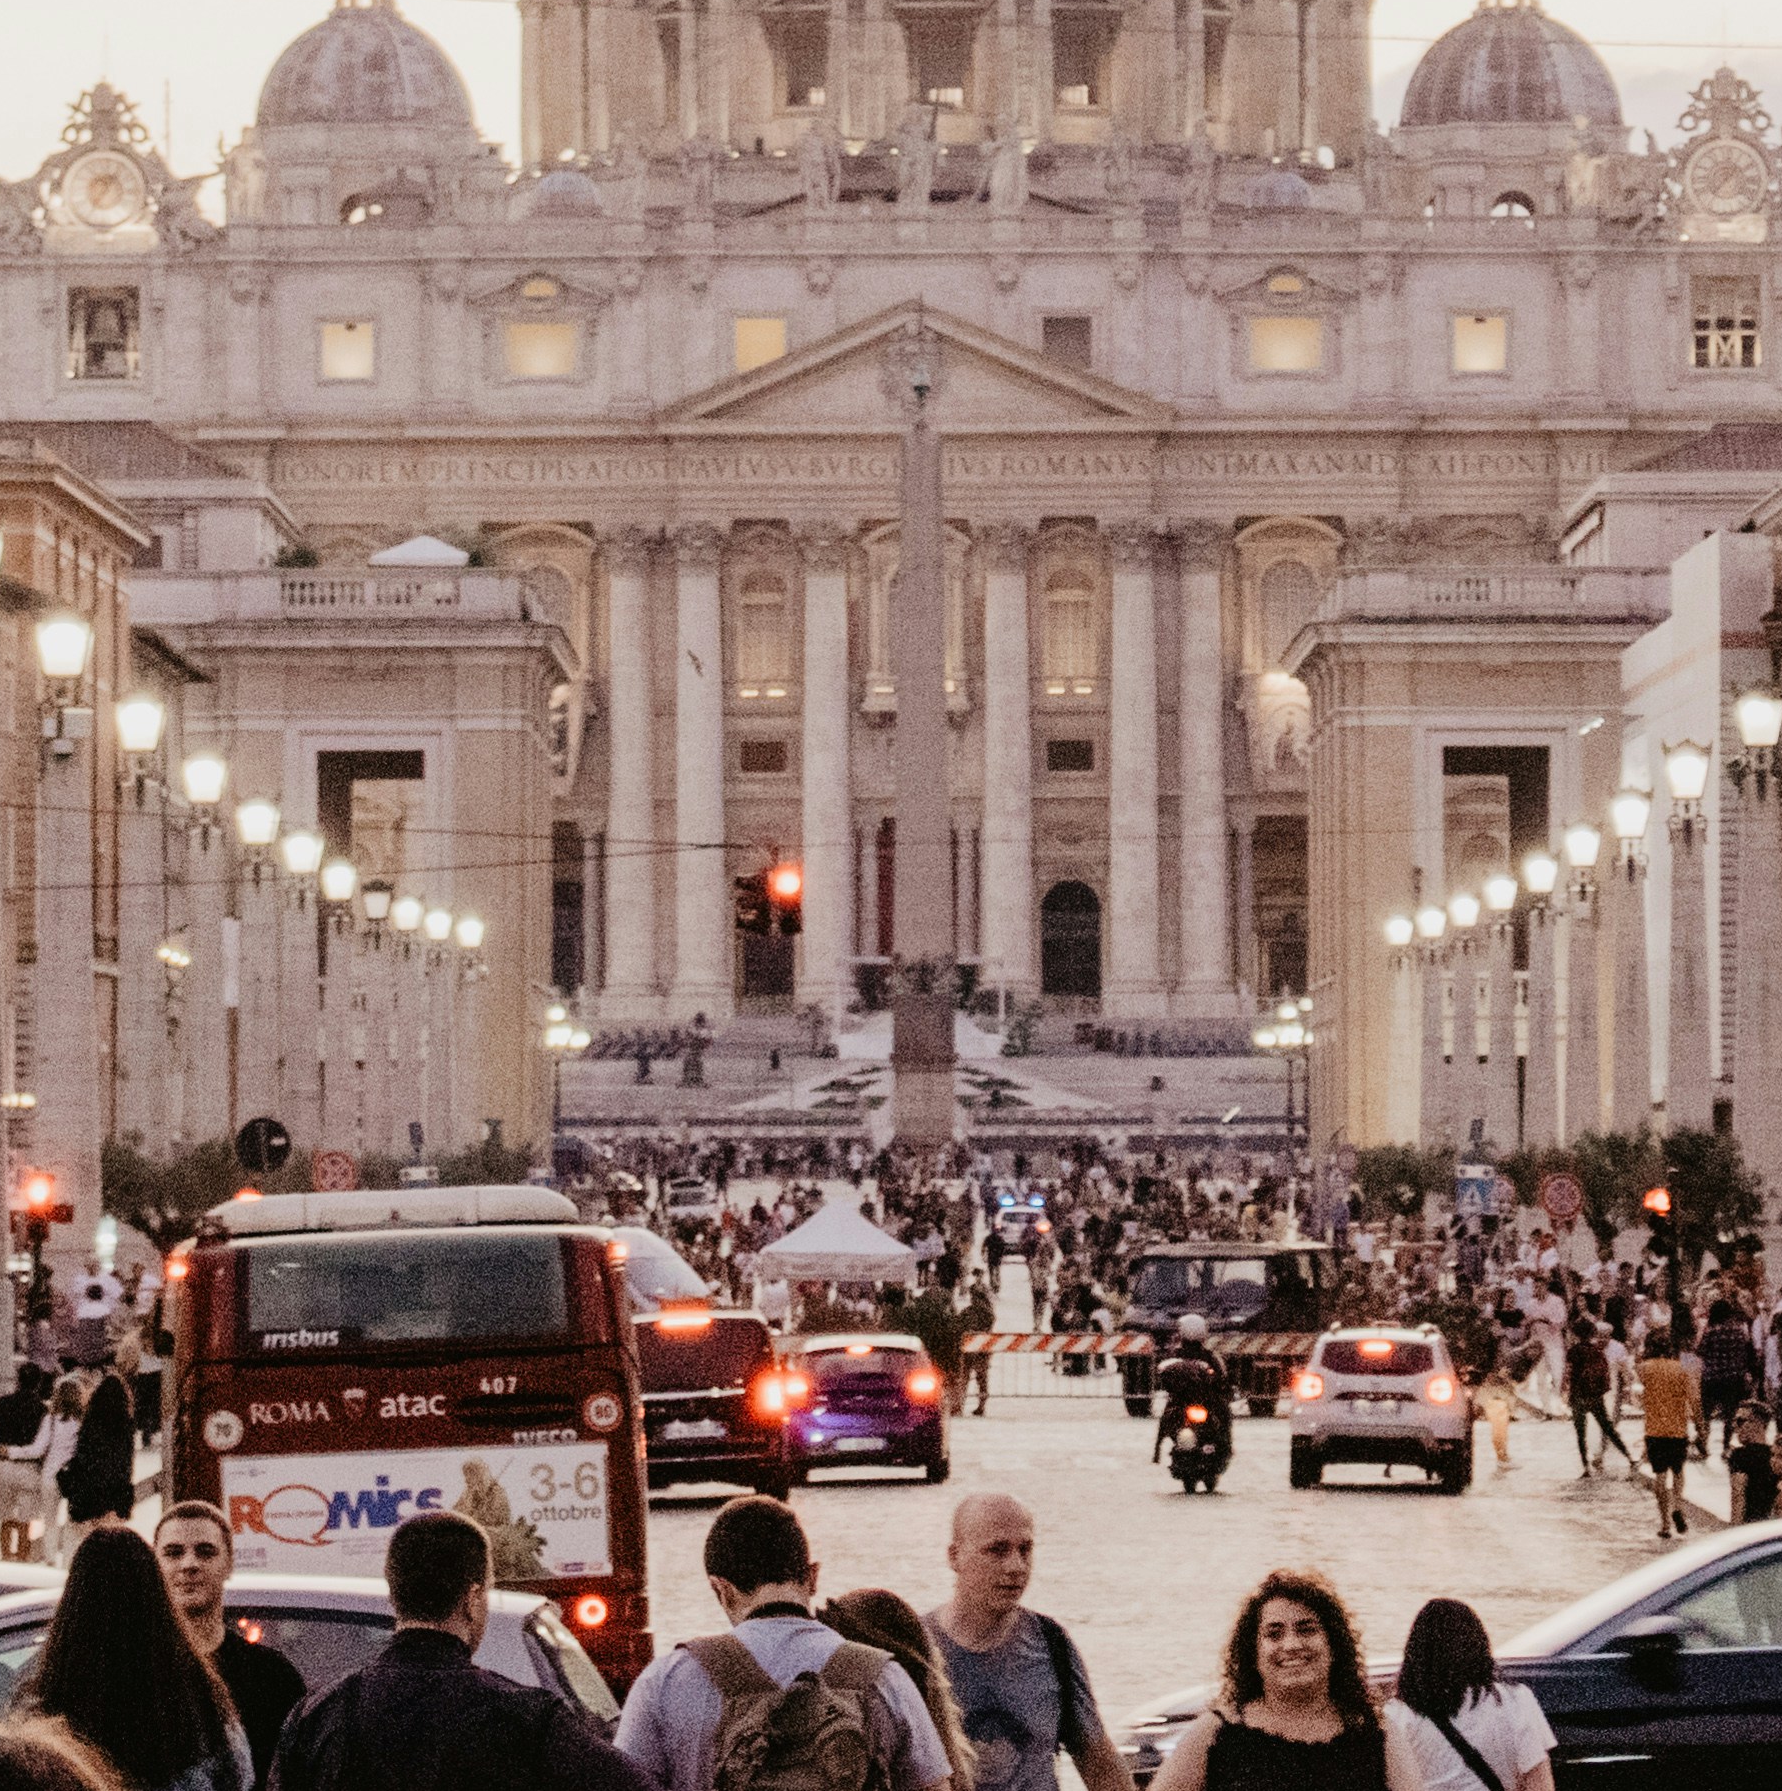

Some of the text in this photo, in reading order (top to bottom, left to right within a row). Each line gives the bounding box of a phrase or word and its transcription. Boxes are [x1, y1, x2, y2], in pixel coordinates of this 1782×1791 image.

[429, 460, 578, 482] PRINCIPIS
[1001, 456, 1151, 476] ROMANVS
[249, 1393, 447, 1424] ROMA atac
[529, 1461, 600, 1502] 3-6
[530, 1505, 602, 1522] ottobre
